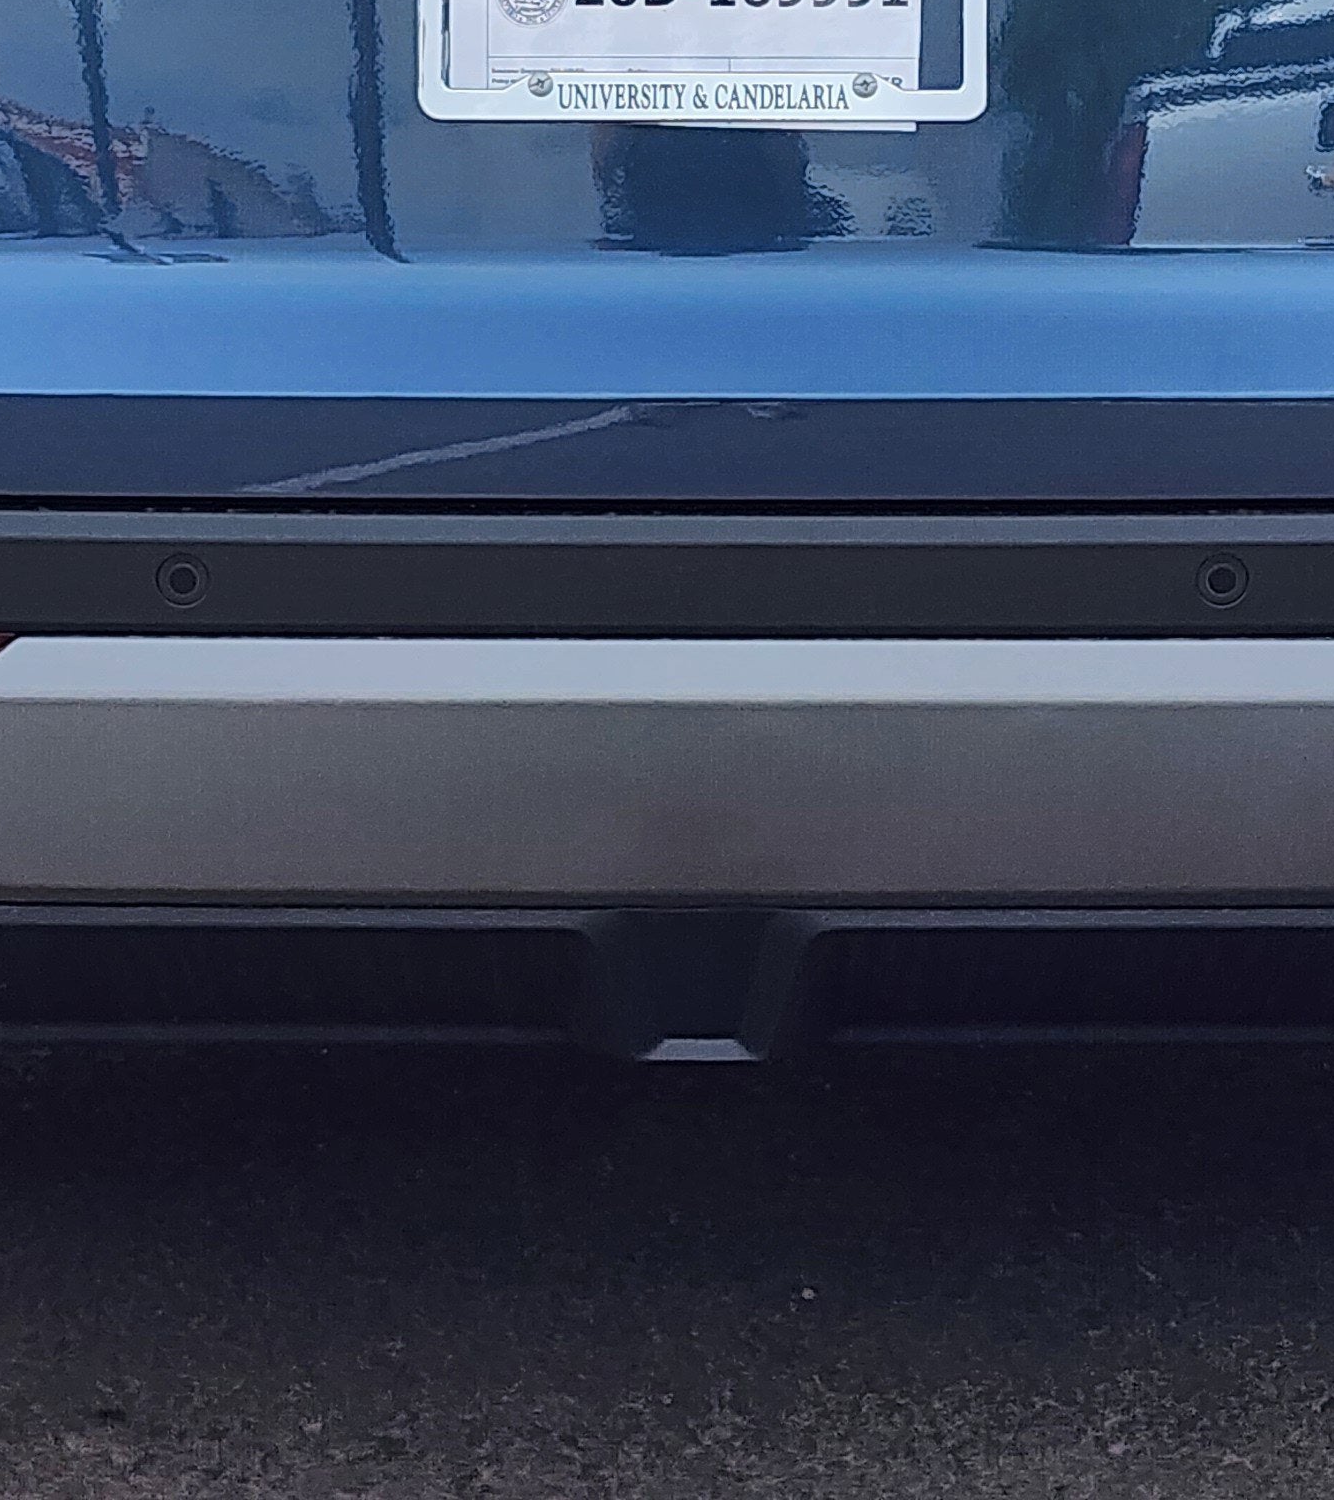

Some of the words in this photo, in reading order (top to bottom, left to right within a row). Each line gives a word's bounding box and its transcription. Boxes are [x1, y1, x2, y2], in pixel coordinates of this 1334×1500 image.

[557, 83, 687, 110] UNIVERSITY
[693, 83, 709, 109] &
[715, 83, 850, 110] CANDELARIA
